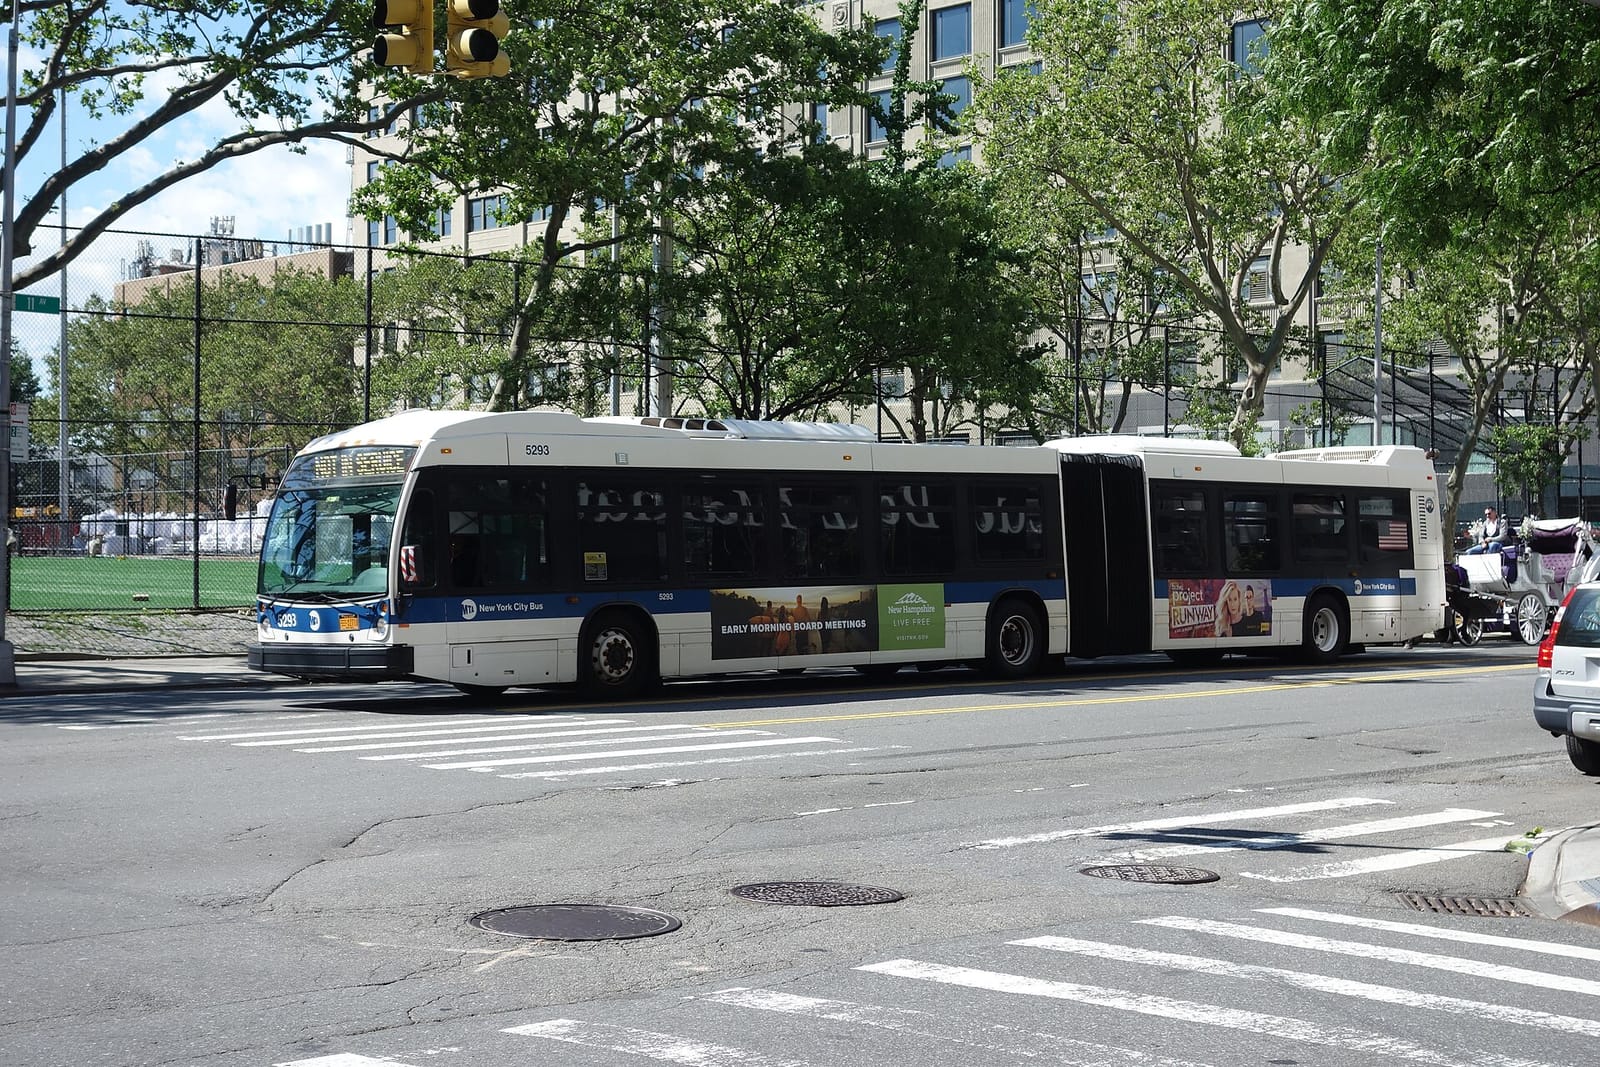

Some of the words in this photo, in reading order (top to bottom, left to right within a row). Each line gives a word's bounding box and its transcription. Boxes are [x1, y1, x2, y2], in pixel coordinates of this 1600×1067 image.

[27, 297, 35, 310] 11
[525, 444, 550, 456] 5293
[314, 455, 338, 478] NOT
[356, 449, 405, 475] SERVICE
[658, 592, 674, 601] 5293
[1172, 587, 1204, 606] project
[479, 604, 496, 612] New
[496, 603, 512, 612] York
[513, 602, 529, 612] City
[530, 602, 544, 610] Bus
[887, 605, 902, 614] New
[902, 604, 936, 615] Hampshire
[277, 613, 297, 628] 5293
[1172, 605, 1214, 626] RUNWAY
[721, 624, 749, 634] EARLY
[750, 622, 792, 633] MORNING
[793, 621, 823, 631] BOARD
[824, 619, 867, 629] MEETINGS
[893, 619, 910, 627] LIVE
[912, 618, 931, 626] FREE
